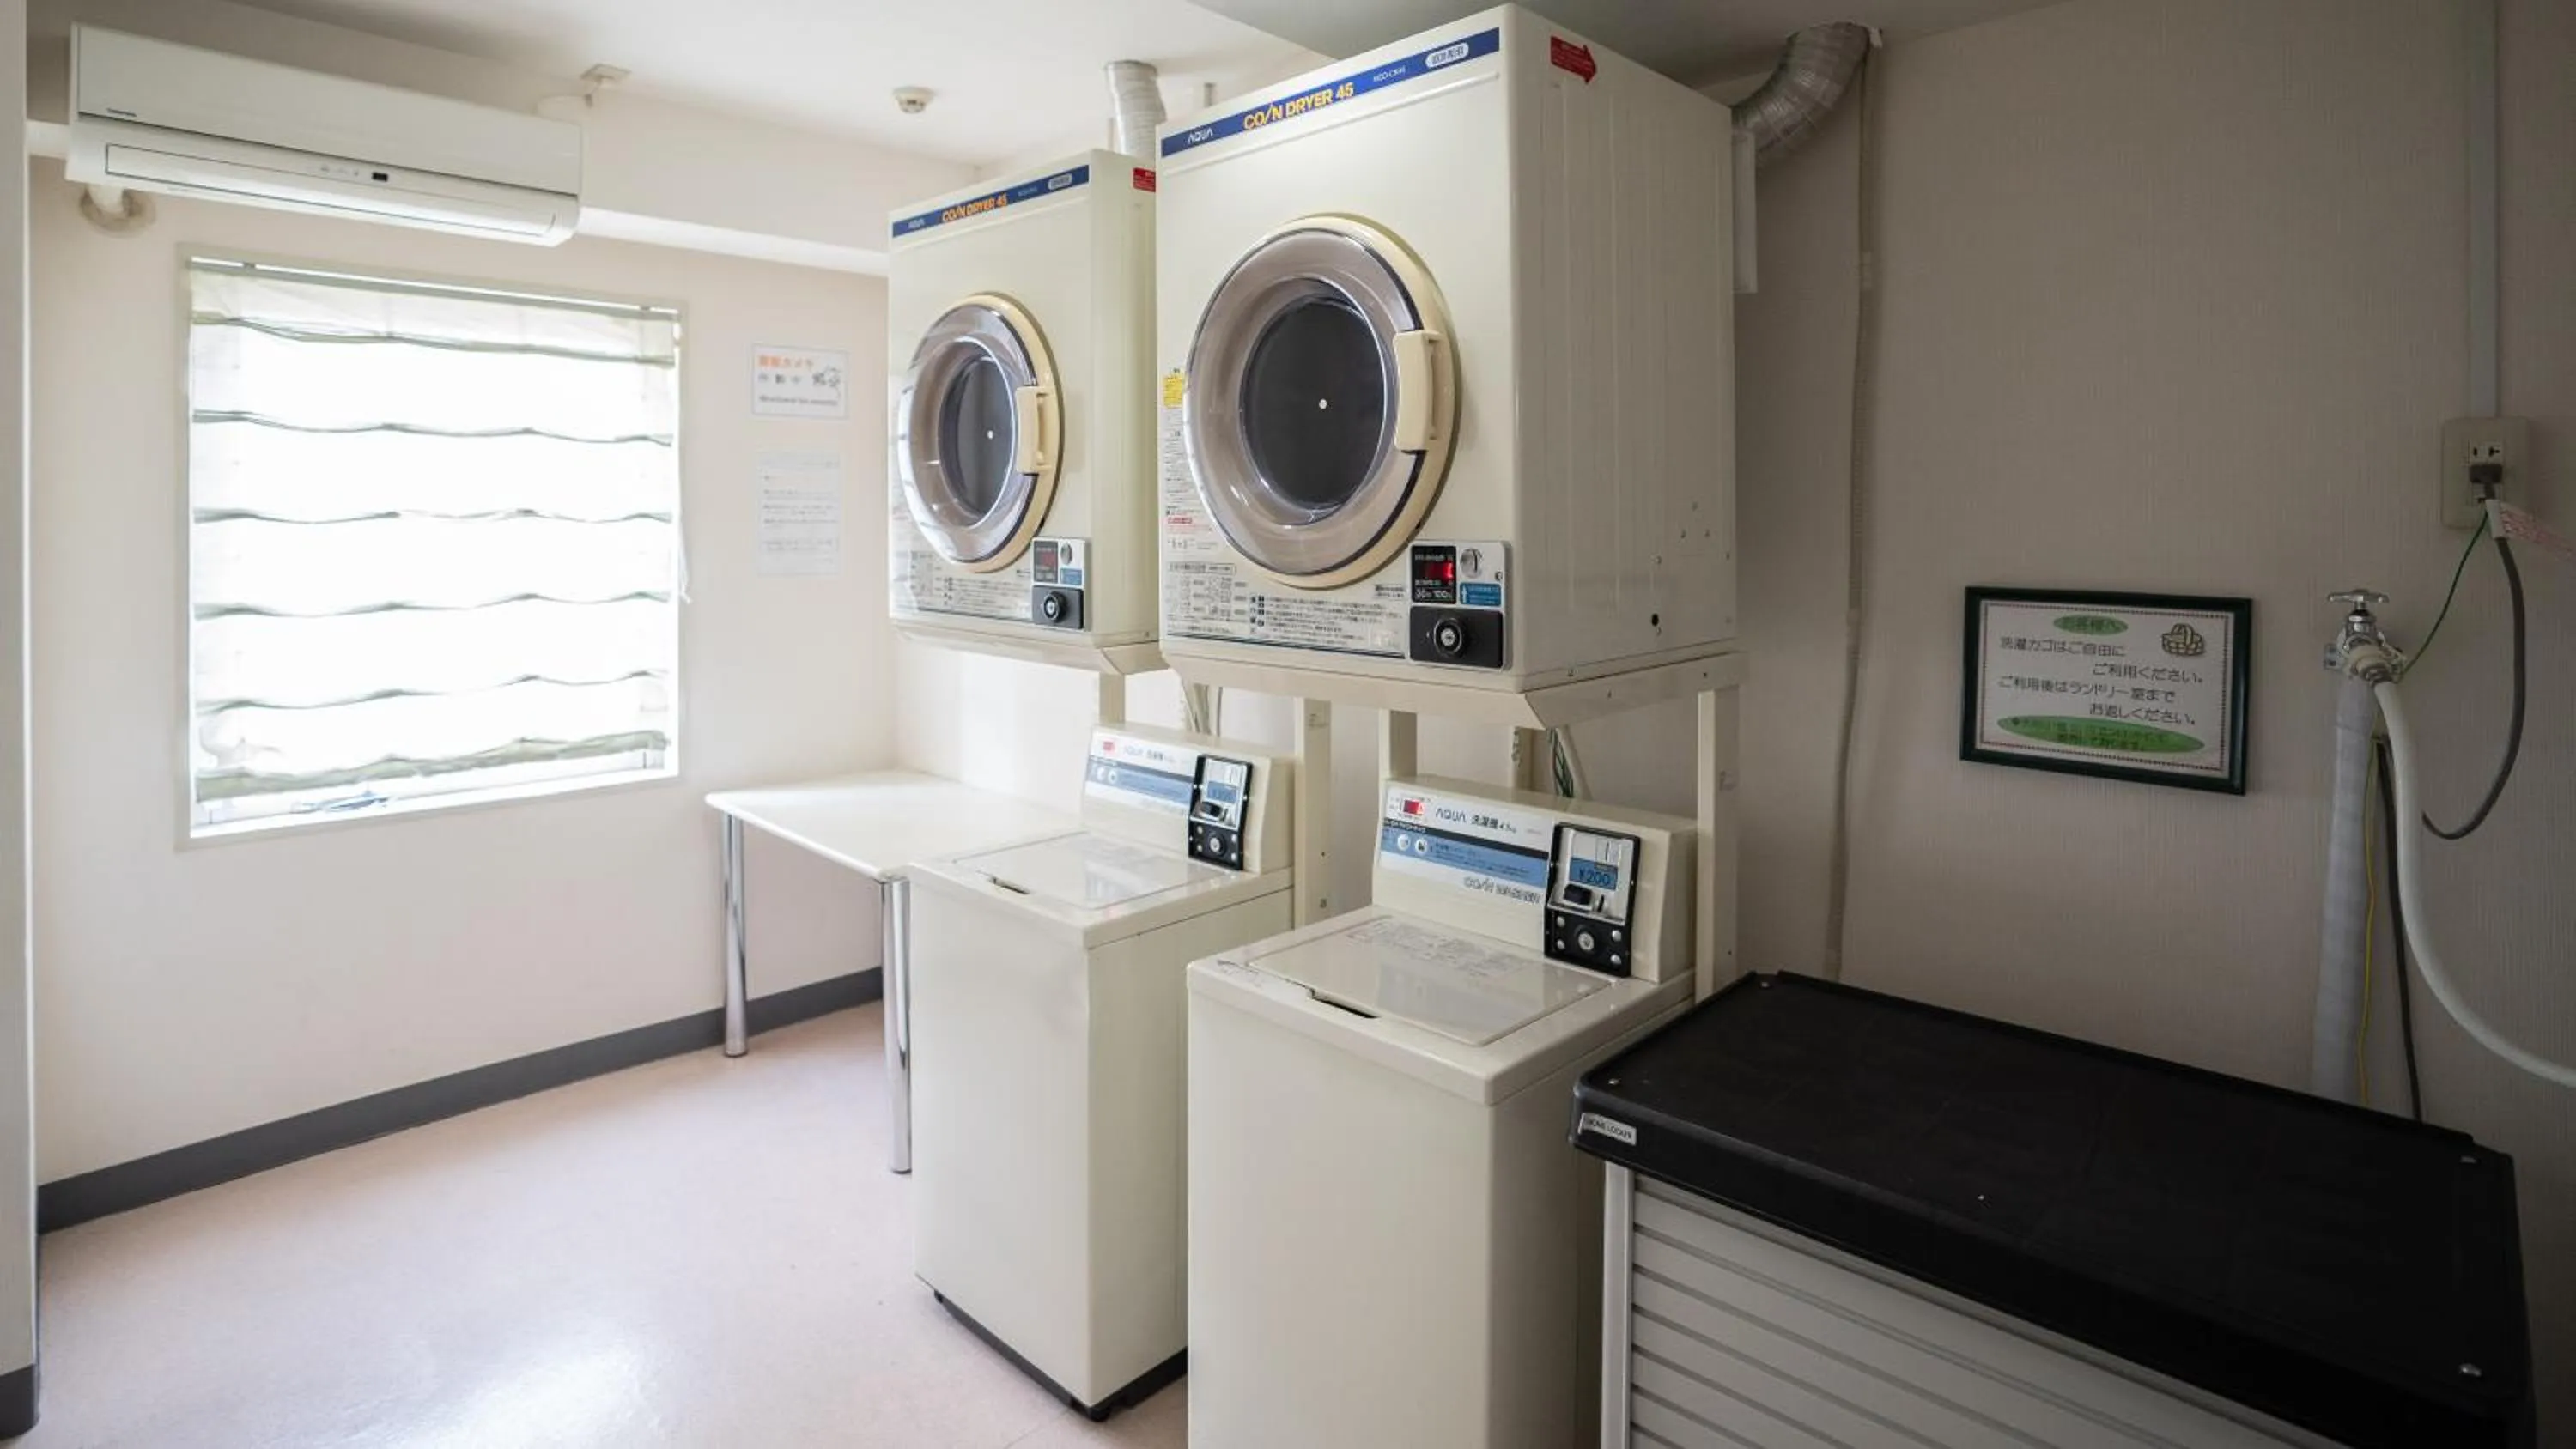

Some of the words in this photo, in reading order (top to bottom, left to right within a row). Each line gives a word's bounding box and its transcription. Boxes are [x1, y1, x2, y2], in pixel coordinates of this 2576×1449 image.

[1188, 127, 1214, 145] AQUA
[1285, 90, 1334, 119] DRYER
[1334, 82, 1355, 101] 45
[2093, 662, 2203, 683] ご利用ください。
[1435, 807, 1467, 823] AQUA
